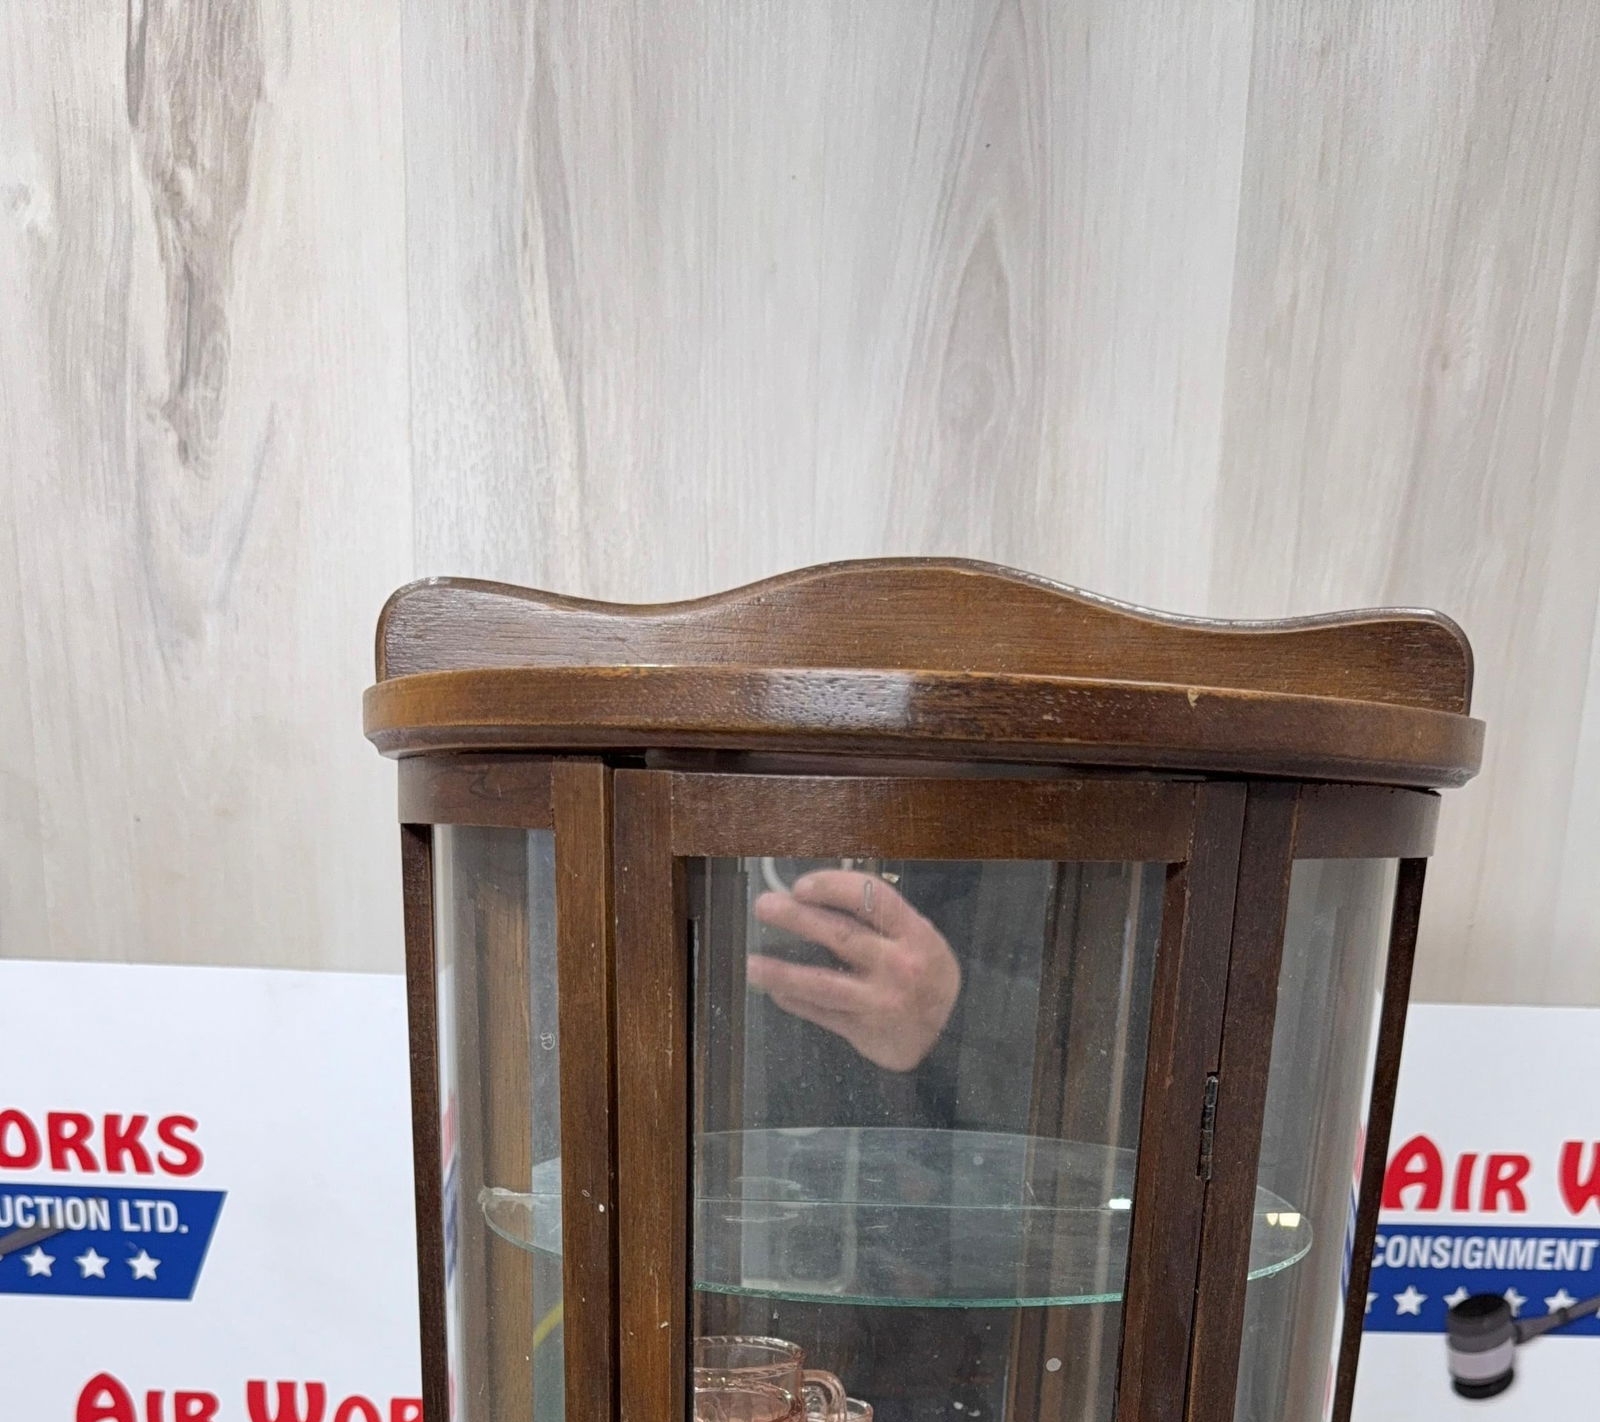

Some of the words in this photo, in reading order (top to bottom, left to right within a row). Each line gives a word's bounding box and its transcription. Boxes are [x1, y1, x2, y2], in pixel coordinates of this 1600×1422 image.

[0, 1108, 204, 1177] ORKS
[1381, 1134, 1532, 1213] AIR
[119, 1199, 190, 1234] LTD.
[1371, 1234, 1599, 1271] CONSIGNMENT
